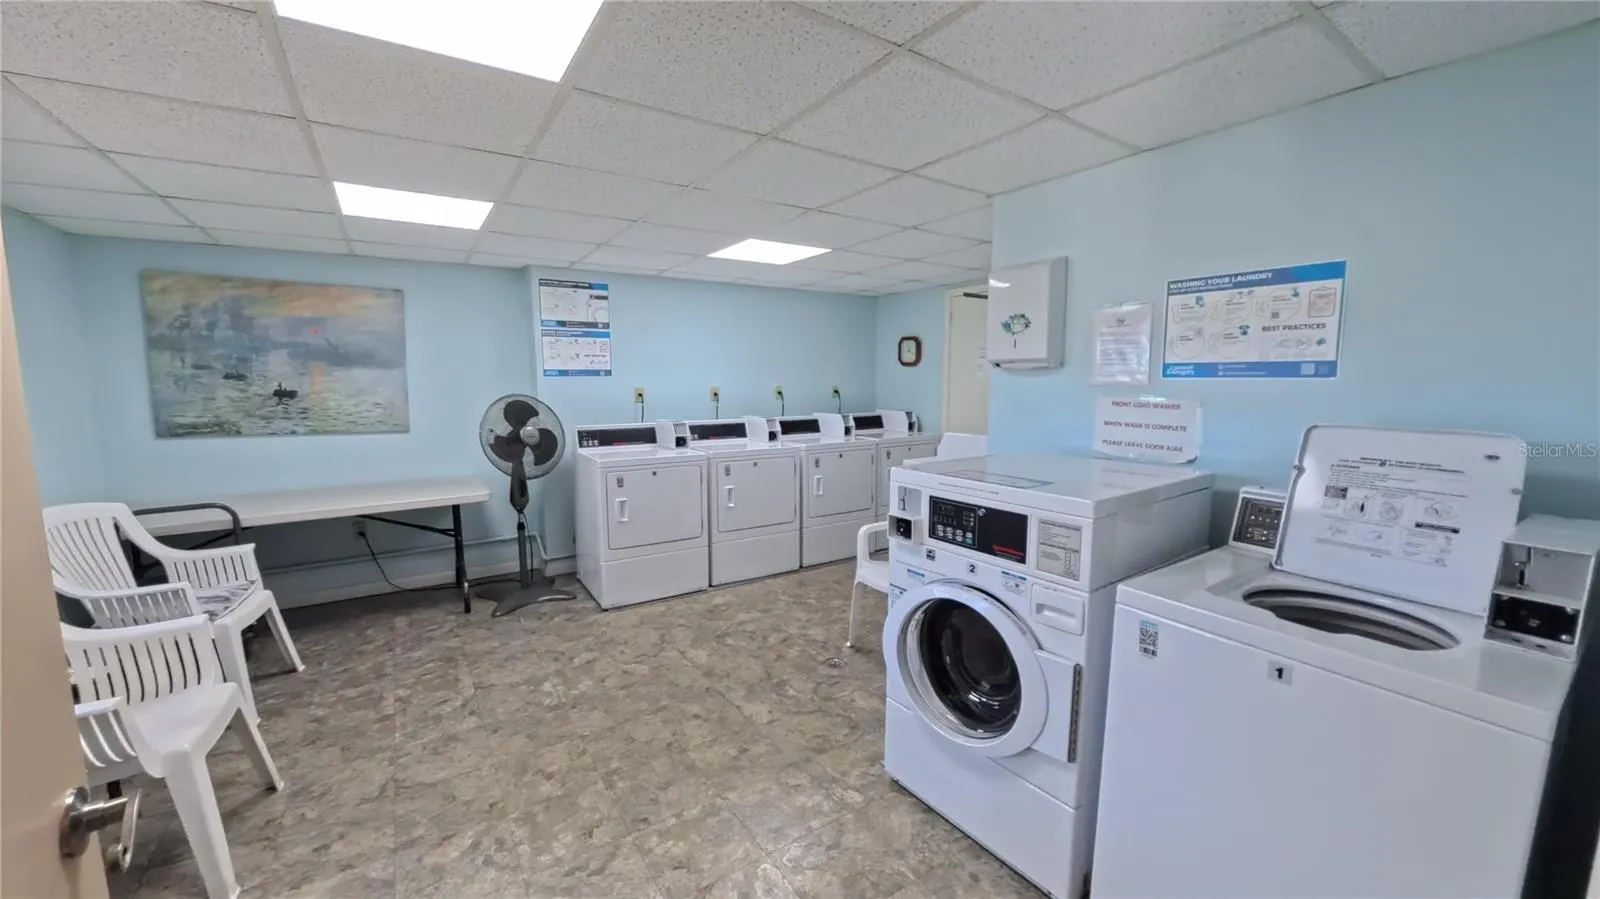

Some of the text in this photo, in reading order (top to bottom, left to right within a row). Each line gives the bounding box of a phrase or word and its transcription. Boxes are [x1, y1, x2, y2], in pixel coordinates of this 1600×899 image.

[1169, 280, 1207, 289] WASHING
[1208, 277, 1231, 286] YOUR
[1232, 272, 1273, 283] LAUNDRY
[1282, 322, 1327, 331] PRACTICES
[1111, 400, 1132, 408] FRONT
[1124, 421, 1143, 429] WASH
[1152, 424, 1187, 432] COMPLETE
[969, 564, 976, 573] 2
[1275, 667, 1284, 679] 1
